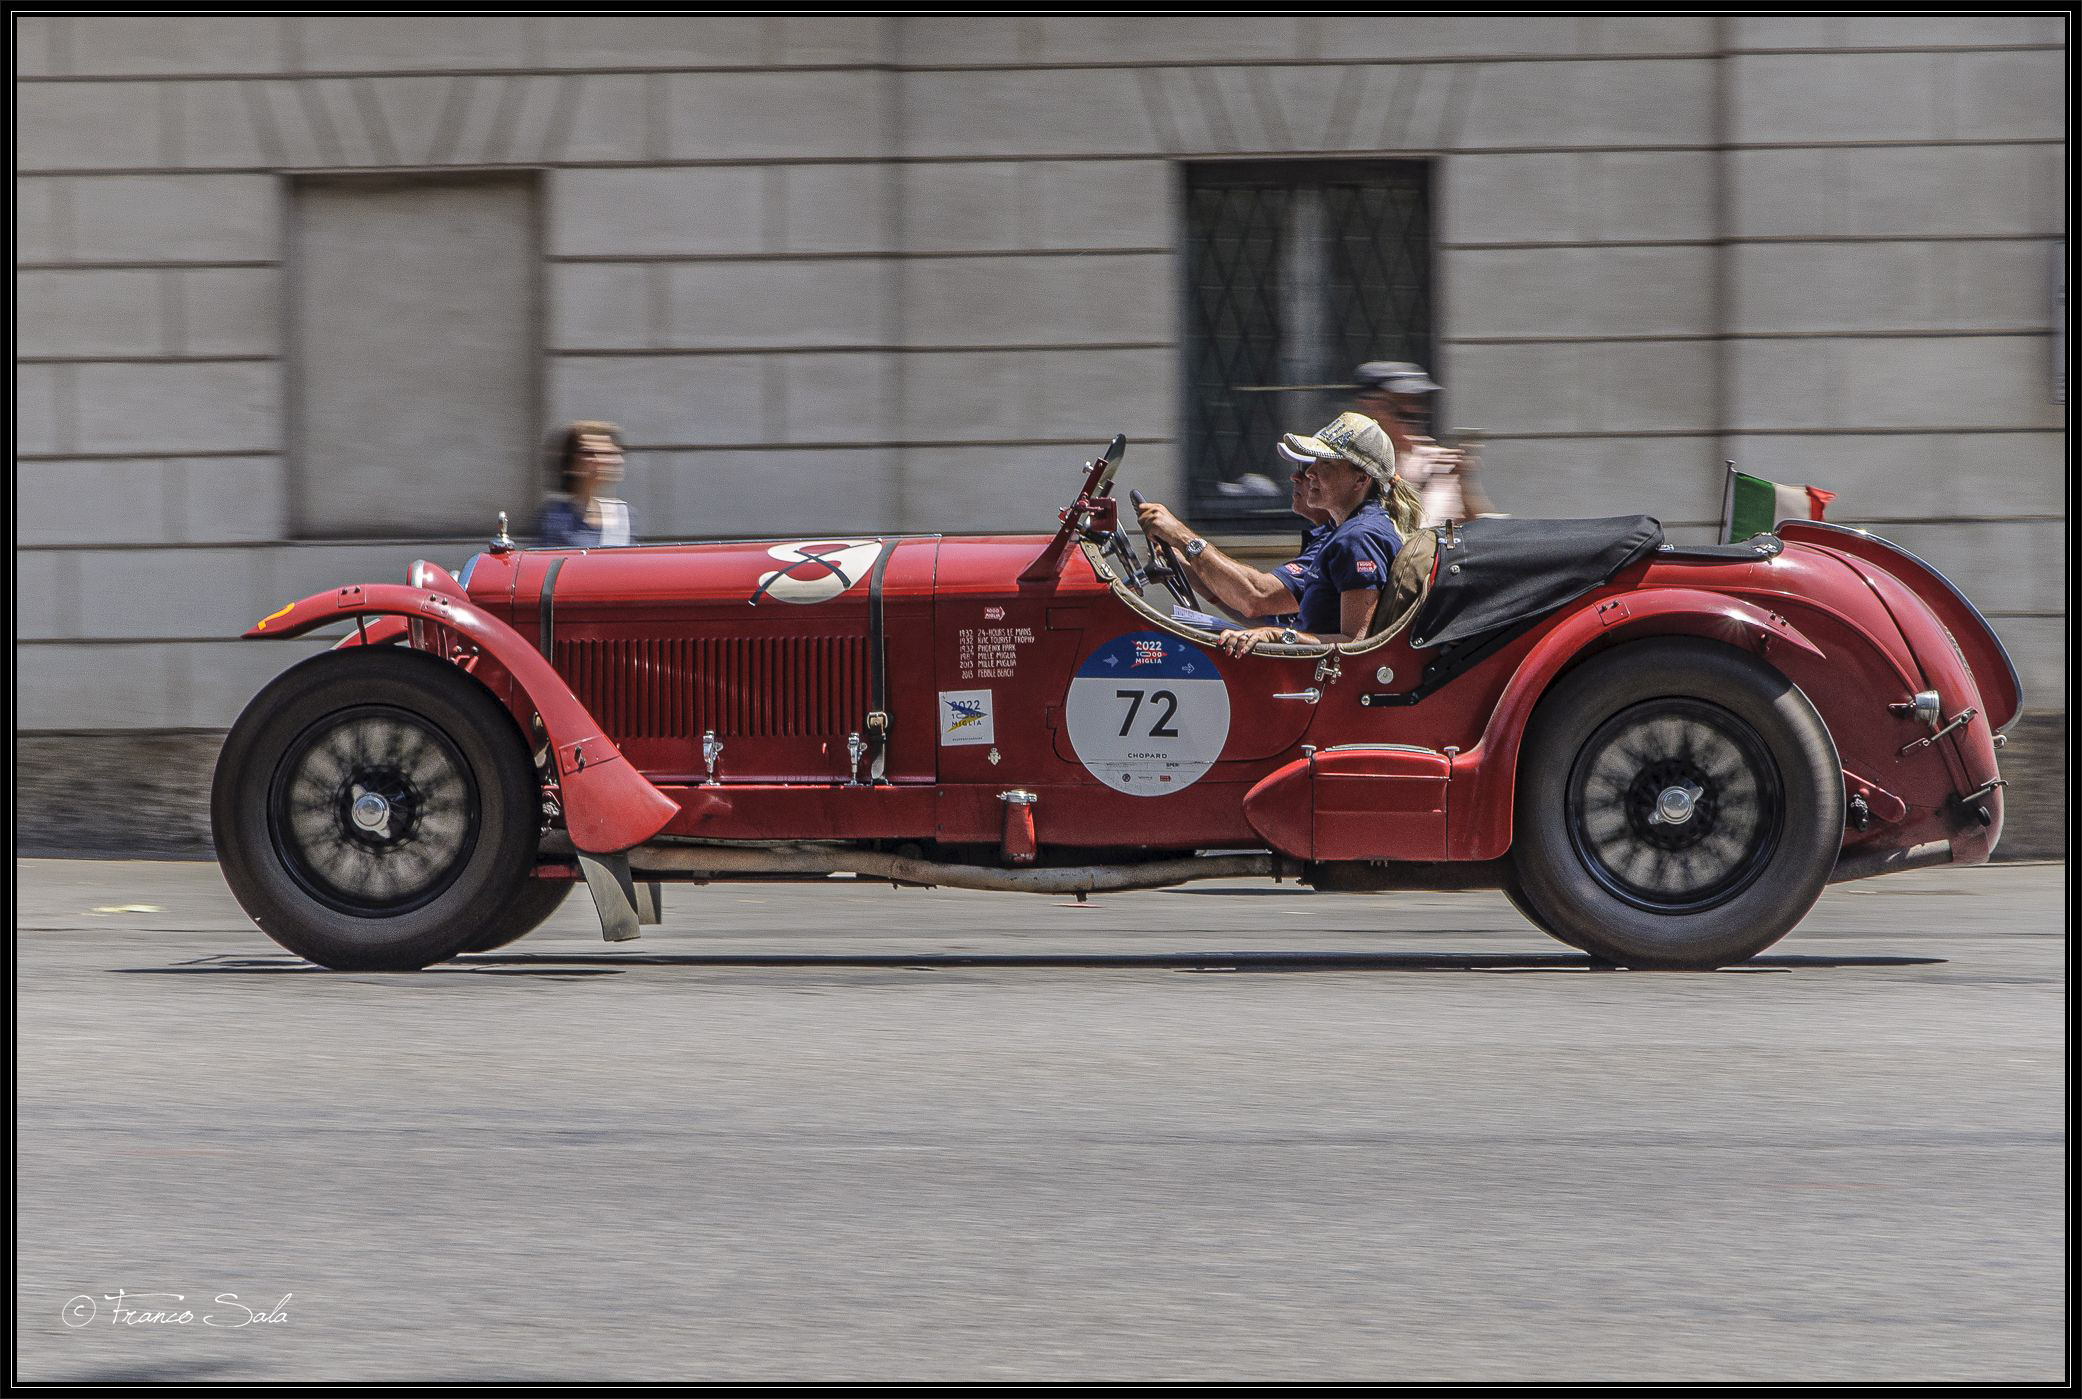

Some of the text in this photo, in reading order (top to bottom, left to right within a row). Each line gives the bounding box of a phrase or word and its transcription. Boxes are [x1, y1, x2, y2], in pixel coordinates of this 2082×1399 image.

[1015, 627, 1032, 636] MANS
[1135, 641, 1162, 651] 2022
[977, 652, 994, 660] MILLE
[995, 651, 1017, 659] MIGLIA
[960, 659, 1017, 668] 2013 MILLE MIGLIA
[951, 700, 981, 711] 2022
[1116, 690, 1178, 737] 72
